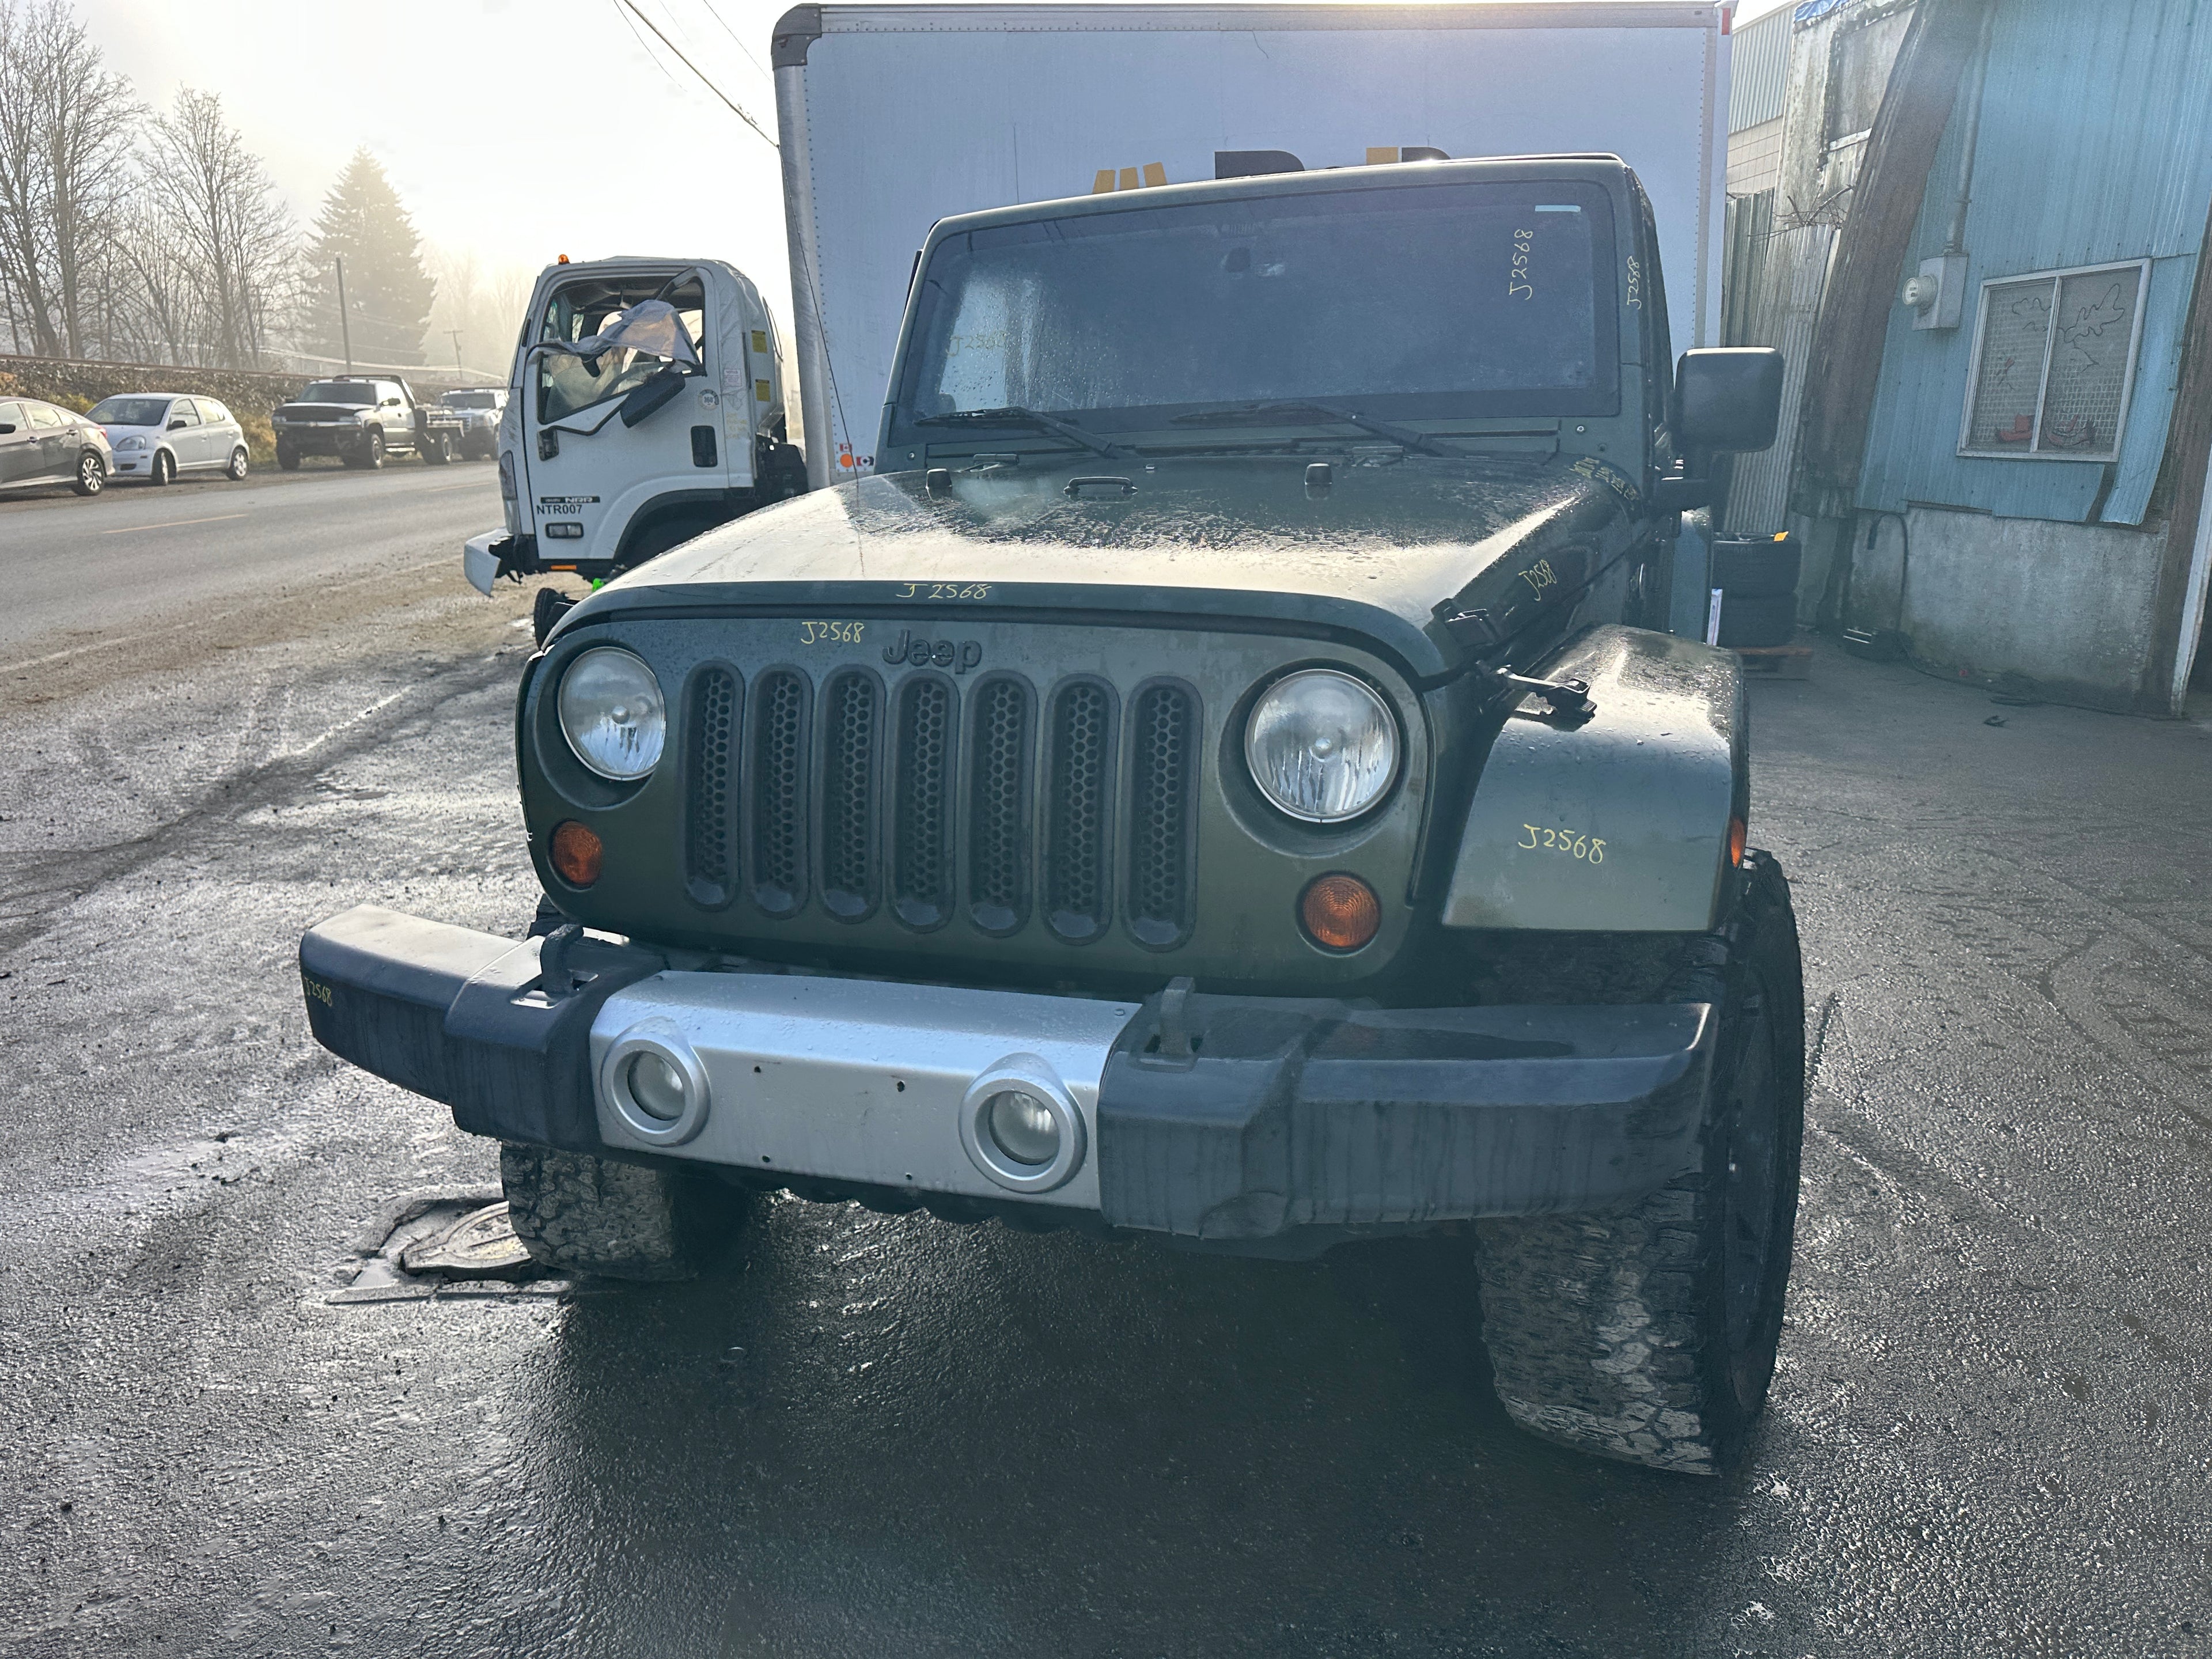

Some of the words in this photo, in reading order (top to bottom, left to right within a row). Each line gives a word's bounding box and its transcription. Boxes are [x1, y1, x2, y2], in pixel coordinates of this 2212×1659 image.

[1509, 229, 1533, 300] J2568
[1626, 255, 1642, 309] J2568
[536, 504, 582, 514] NTR007
[1518, 559, 1557, 601] J2568
[801, 622, 865, 644] J2568
[882, 628, 982, 675] Jeep
[1518, 824, 1607, 864] J2568
[303, 976, 332, 1007] J2568
